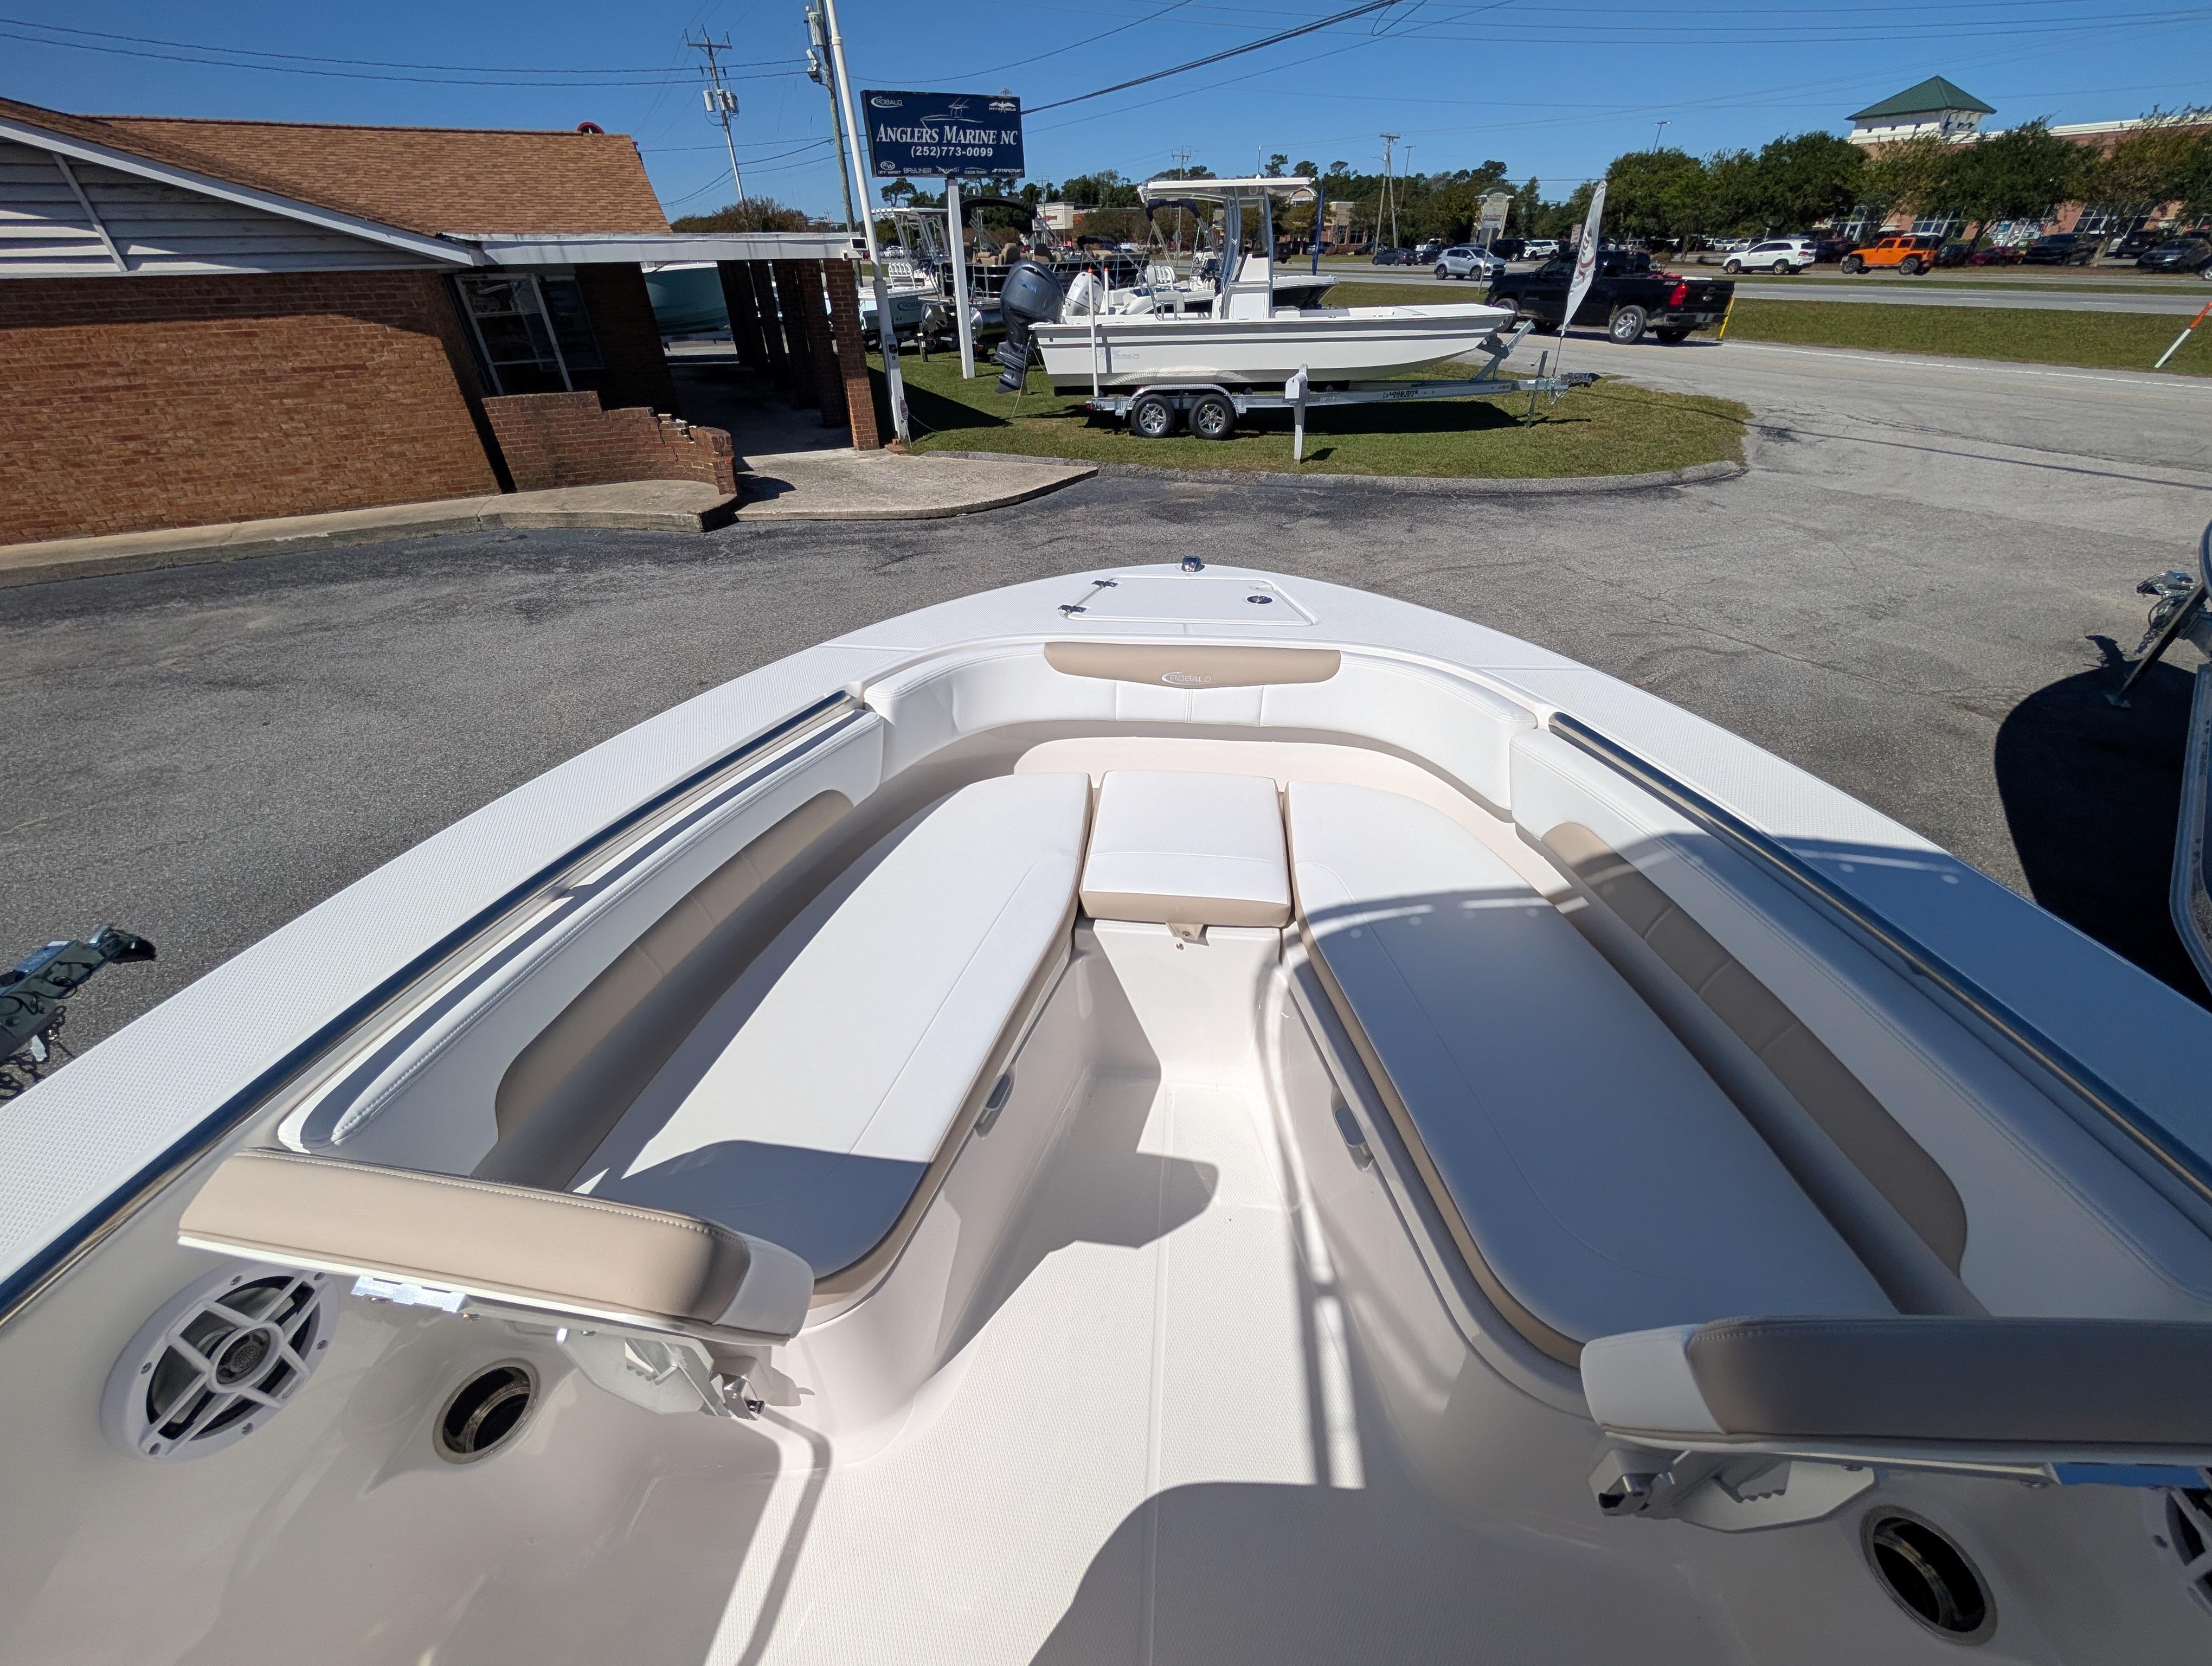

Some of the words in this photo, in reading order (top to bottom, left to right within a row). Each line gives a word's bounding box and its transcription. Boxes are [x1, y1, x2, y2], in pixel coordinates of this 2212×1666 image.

[876, 123, 939, 143] ANGLERS
[943, 125, 997, 144] MARINE
[1000, 130, 1018, 145] NC
[911, 145, 993, 158] (252)773-0099
